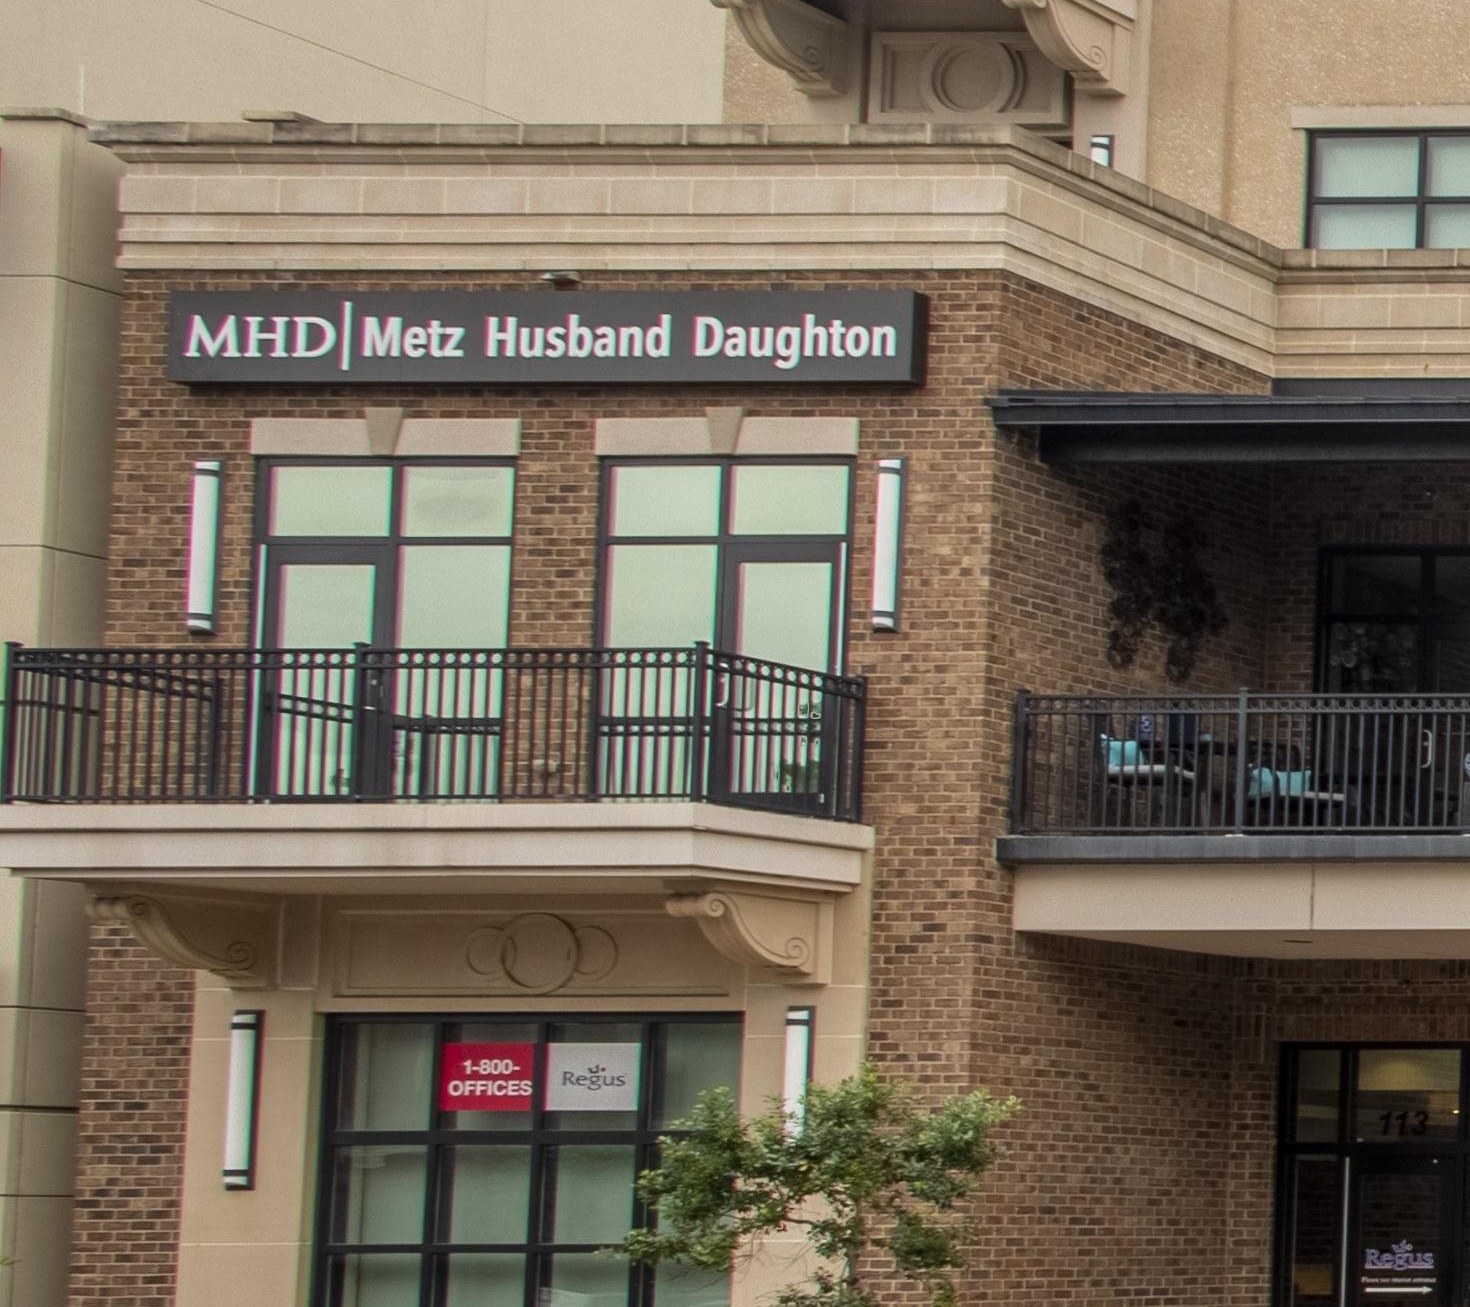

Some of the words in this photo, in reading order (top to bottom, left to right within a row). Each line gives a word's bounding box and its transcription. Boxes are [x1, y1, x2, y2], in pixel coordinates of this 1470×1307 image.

[183, 314, 336, 359] MHD
[361, 315, 465, 359] Metz
[485, 313, 672, 359] Husband
[693, 313, 897, 371] Daughton
[462, 1058, 522, 1075] 1-800-
[447, 1080, 533, 1097] OFFICES
[562, 1070, 627, 1090] Regus
[1379, 1110, 1429, 1136] 113
[1364, 1248, 1435, 1271] Regus
